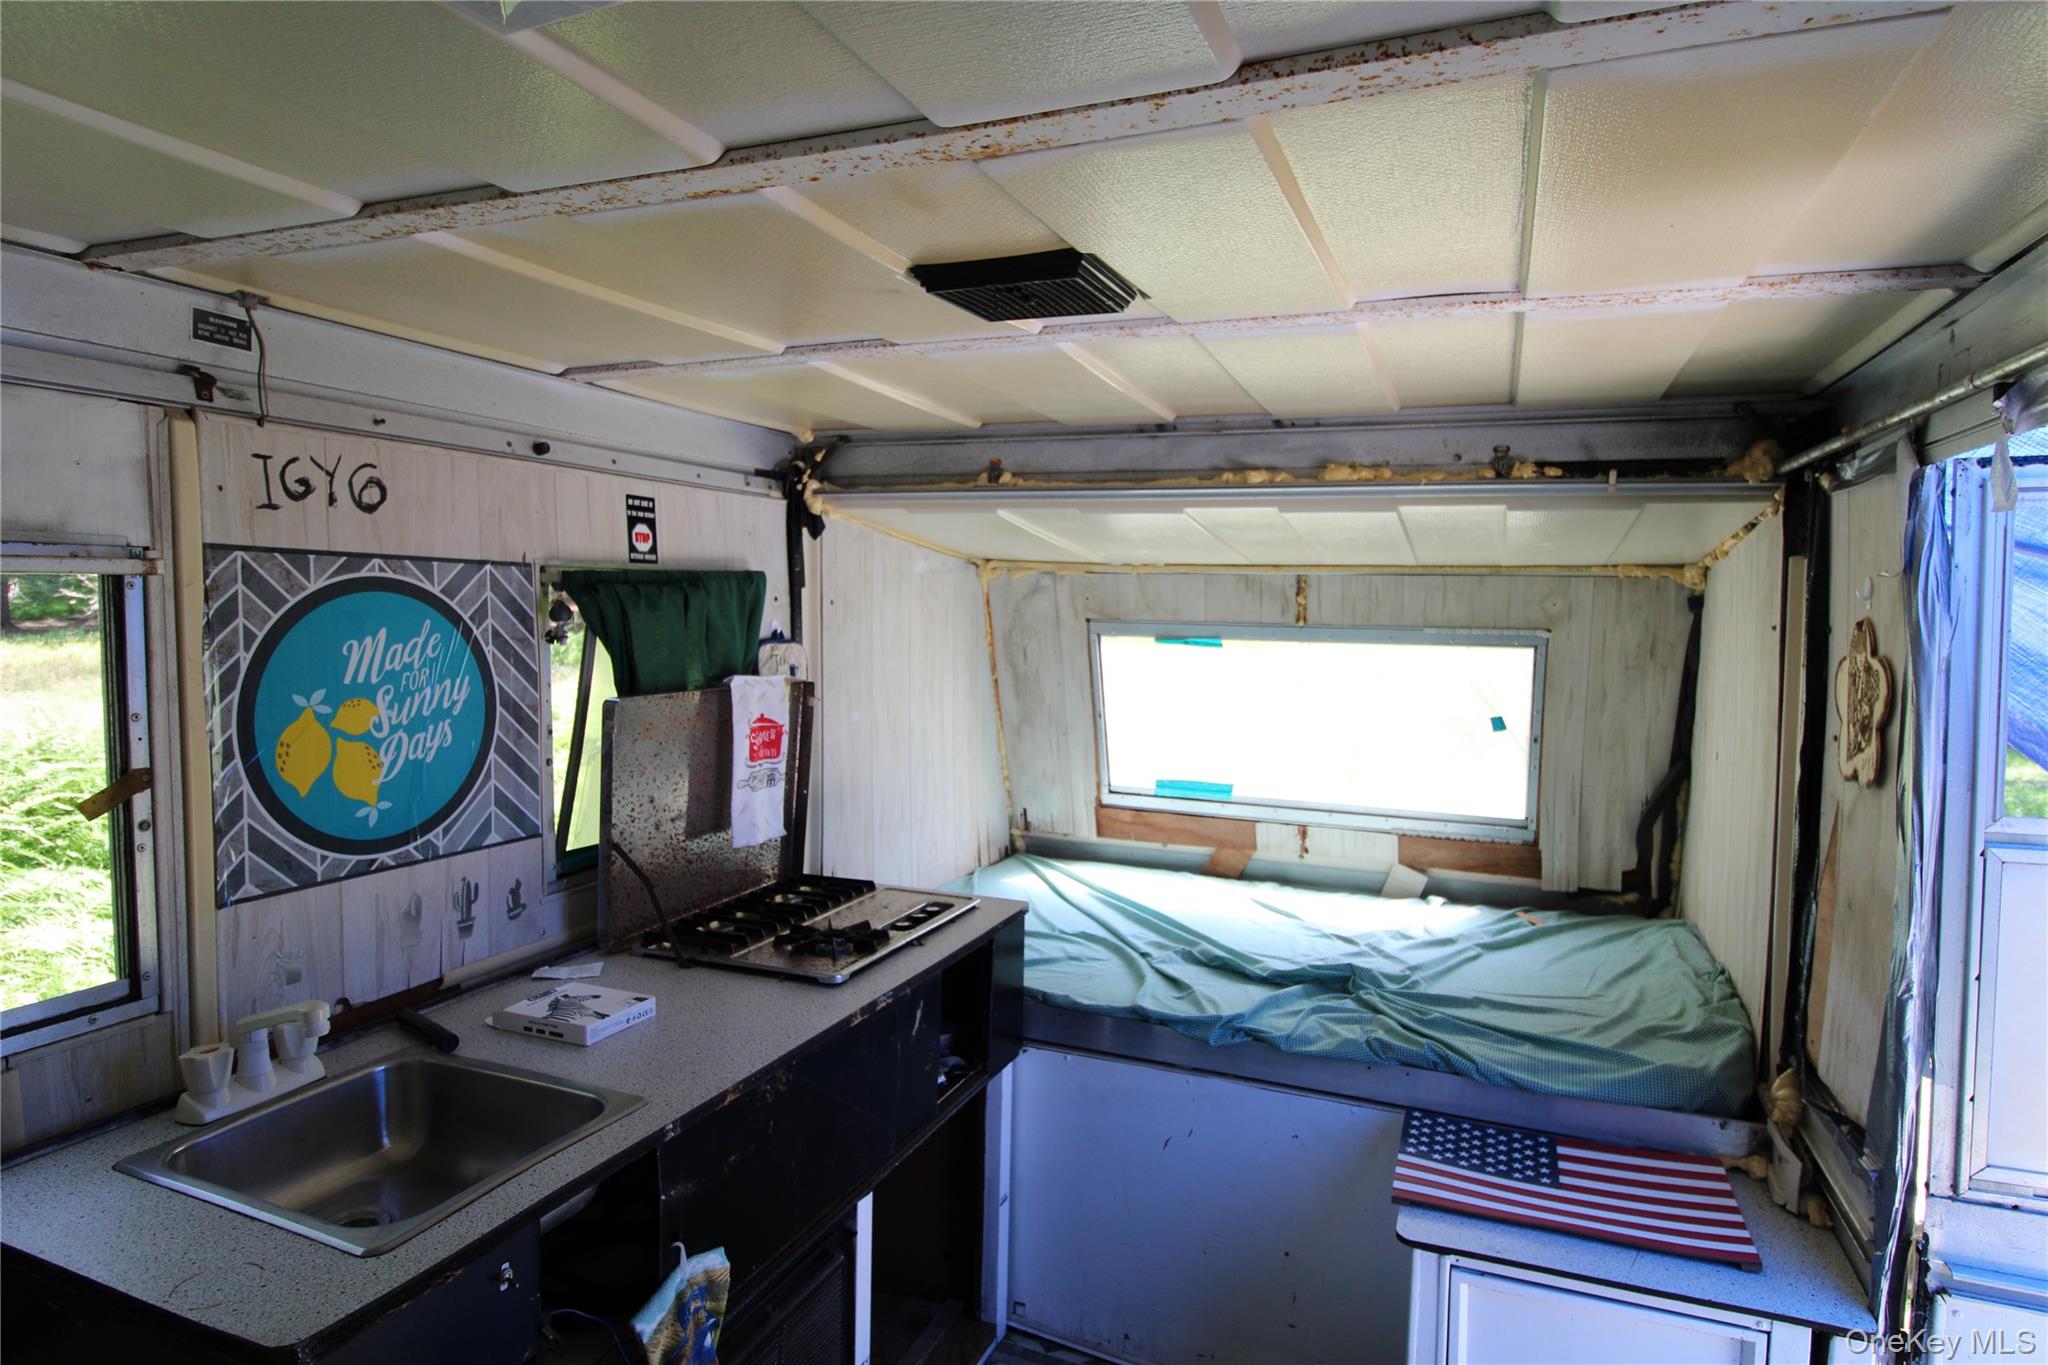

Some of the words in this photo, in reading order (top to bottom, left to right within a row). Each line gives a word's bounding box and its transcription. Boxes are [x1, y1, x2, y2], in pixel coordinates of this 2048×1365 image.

[208, 316, 238, 328] WARNING
[634, 531, 651, 545] STOP
[342, 619, 442, 685] Made
[400, 667, 430, 692] FOR
[369, 675, 471, 739] Sunny
[372, 718, 453, 786] Days
